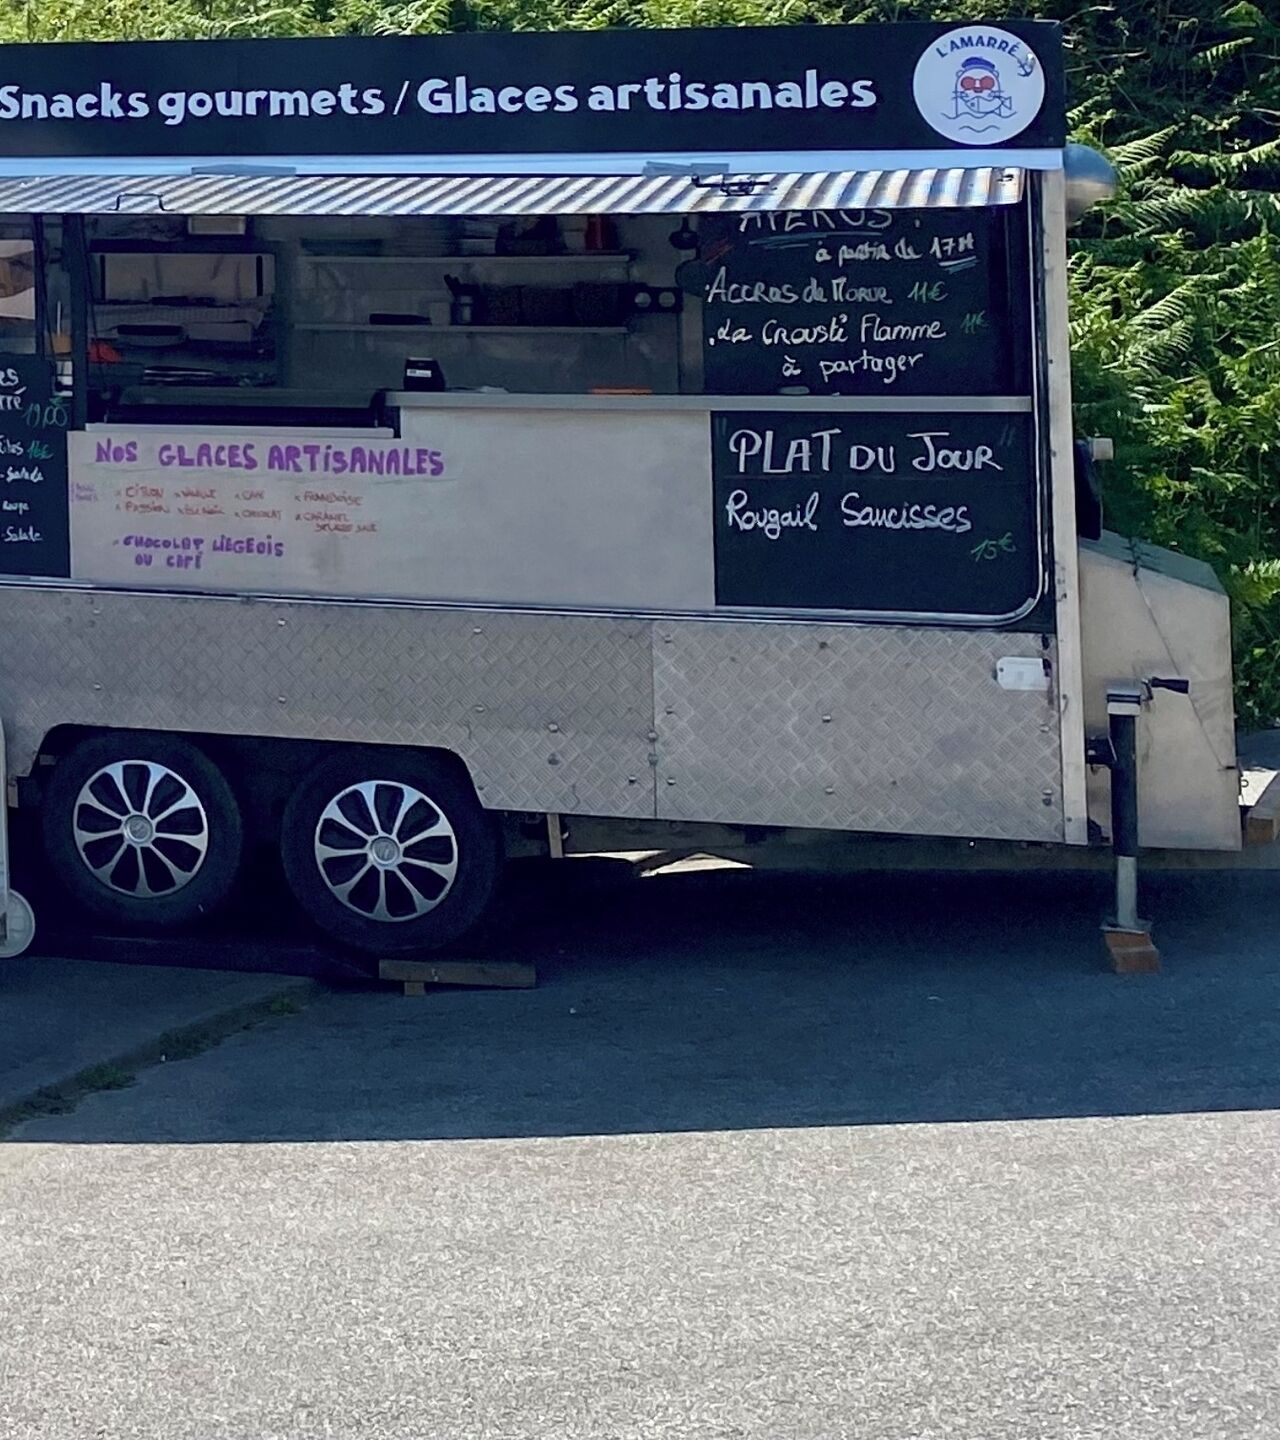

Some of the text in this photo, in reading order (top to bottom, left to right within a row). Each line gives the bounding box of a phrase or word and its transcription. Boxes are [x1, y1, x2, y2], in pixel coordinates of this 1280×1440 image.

[157, 81, 385, 125] gourmets
[417, 76, 578, 114] Glaces
[587, 69, 877, 111] artisanales
[819, 349, 924, 384] partager
[158, 443, 259, 471] GLACES
[729, 428, 842, 474] PLAT
[849, 445, 895, 472] DU
[725, 489, 972, 540] Rougail Saucisses
